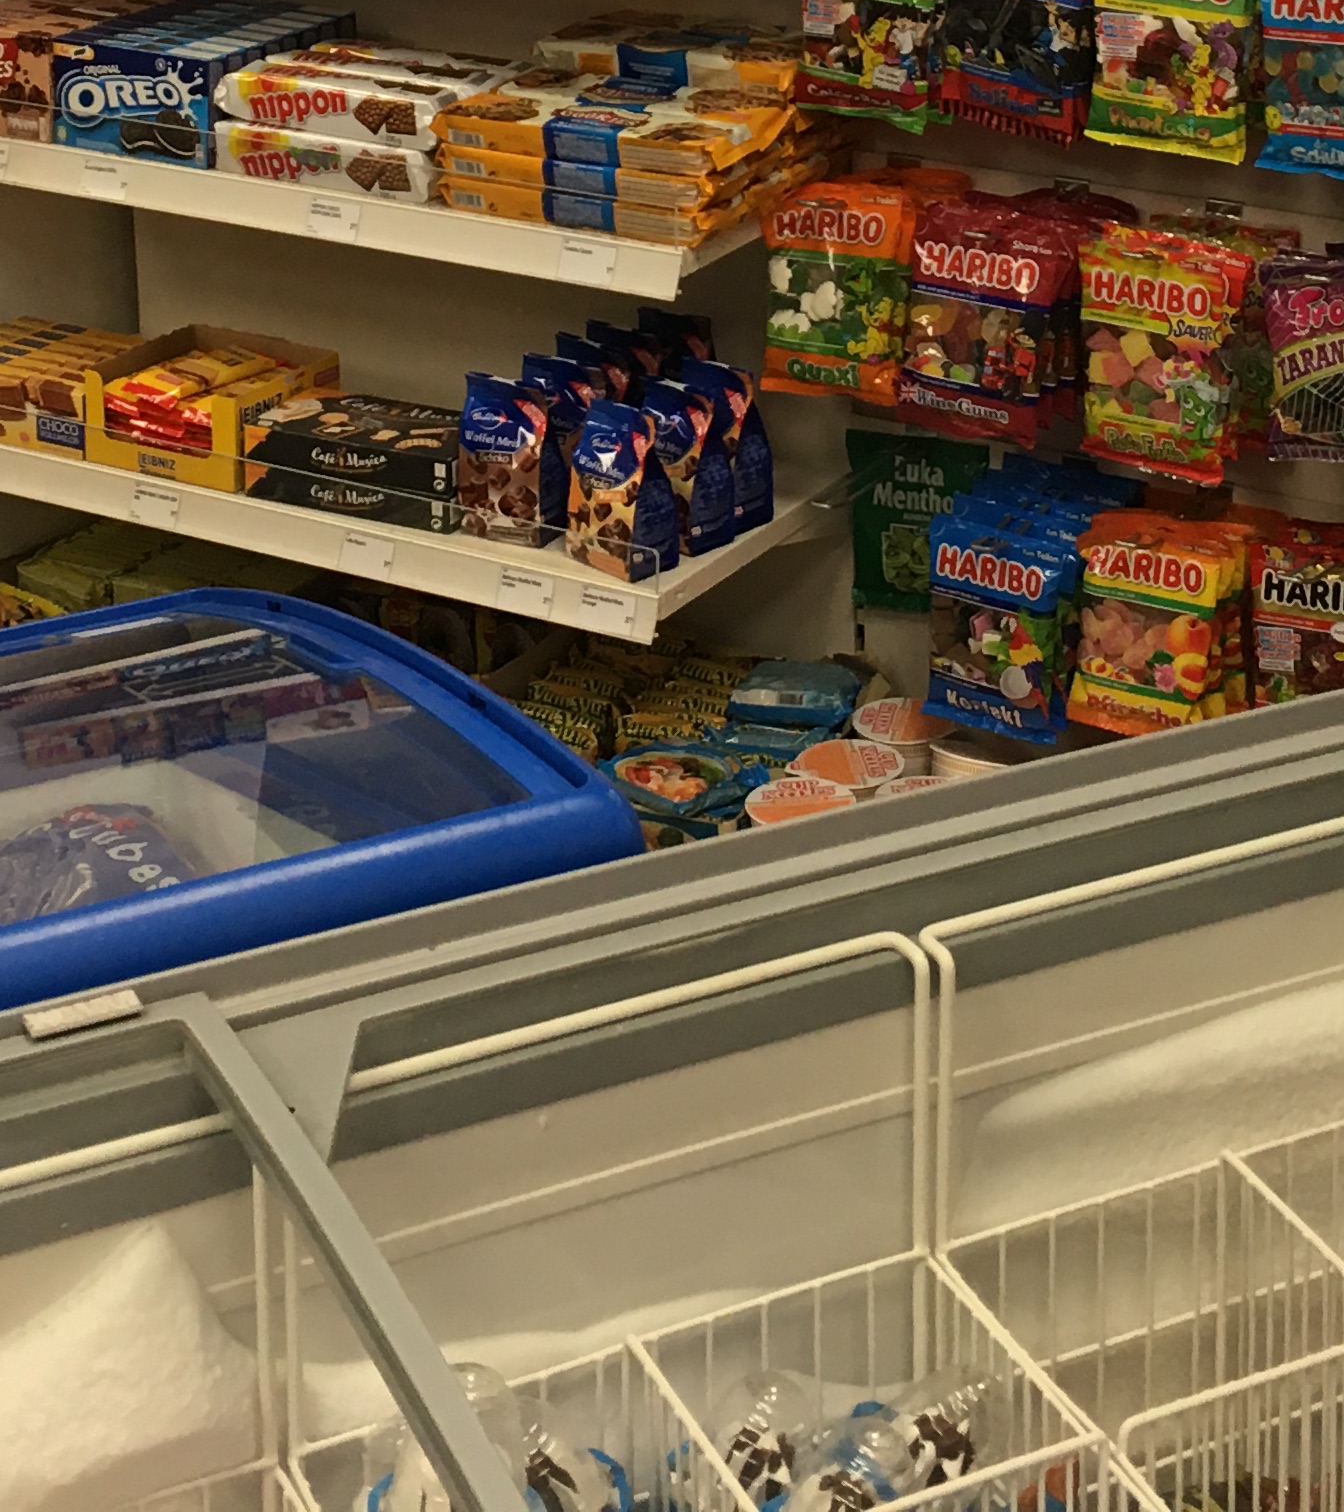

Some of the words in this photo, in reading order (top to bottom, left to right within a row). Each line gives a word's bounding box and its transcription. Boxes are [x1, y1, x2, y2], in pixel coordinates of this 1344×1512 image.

[83, 63, 122, 76] ORIGINAL
[66, 76, 181, 117] OREO
[249, 88, 347, 123] nippon
[773, 208, 886, 246] HARIBO
[920, 240, 1041, 293] HARIBO
[1091, 267, 1211, 319] HARIBO
[916, 386, 957, 411] Wine
[957, 397, 1010, 424] Gums
[38, 417, 80, 436] CHOCO
[137, 450, 177, 472] LEIBNIZ
[311, 445, 336, 465] Café
[346, 449, 389, 468] Musica
[310, 483, 336, 502] Café
[345, 489, 386, 507] Musica
[936, 543, 1044, 601] HARIBO
[1087, 544, 1204, 595] HARIBO
